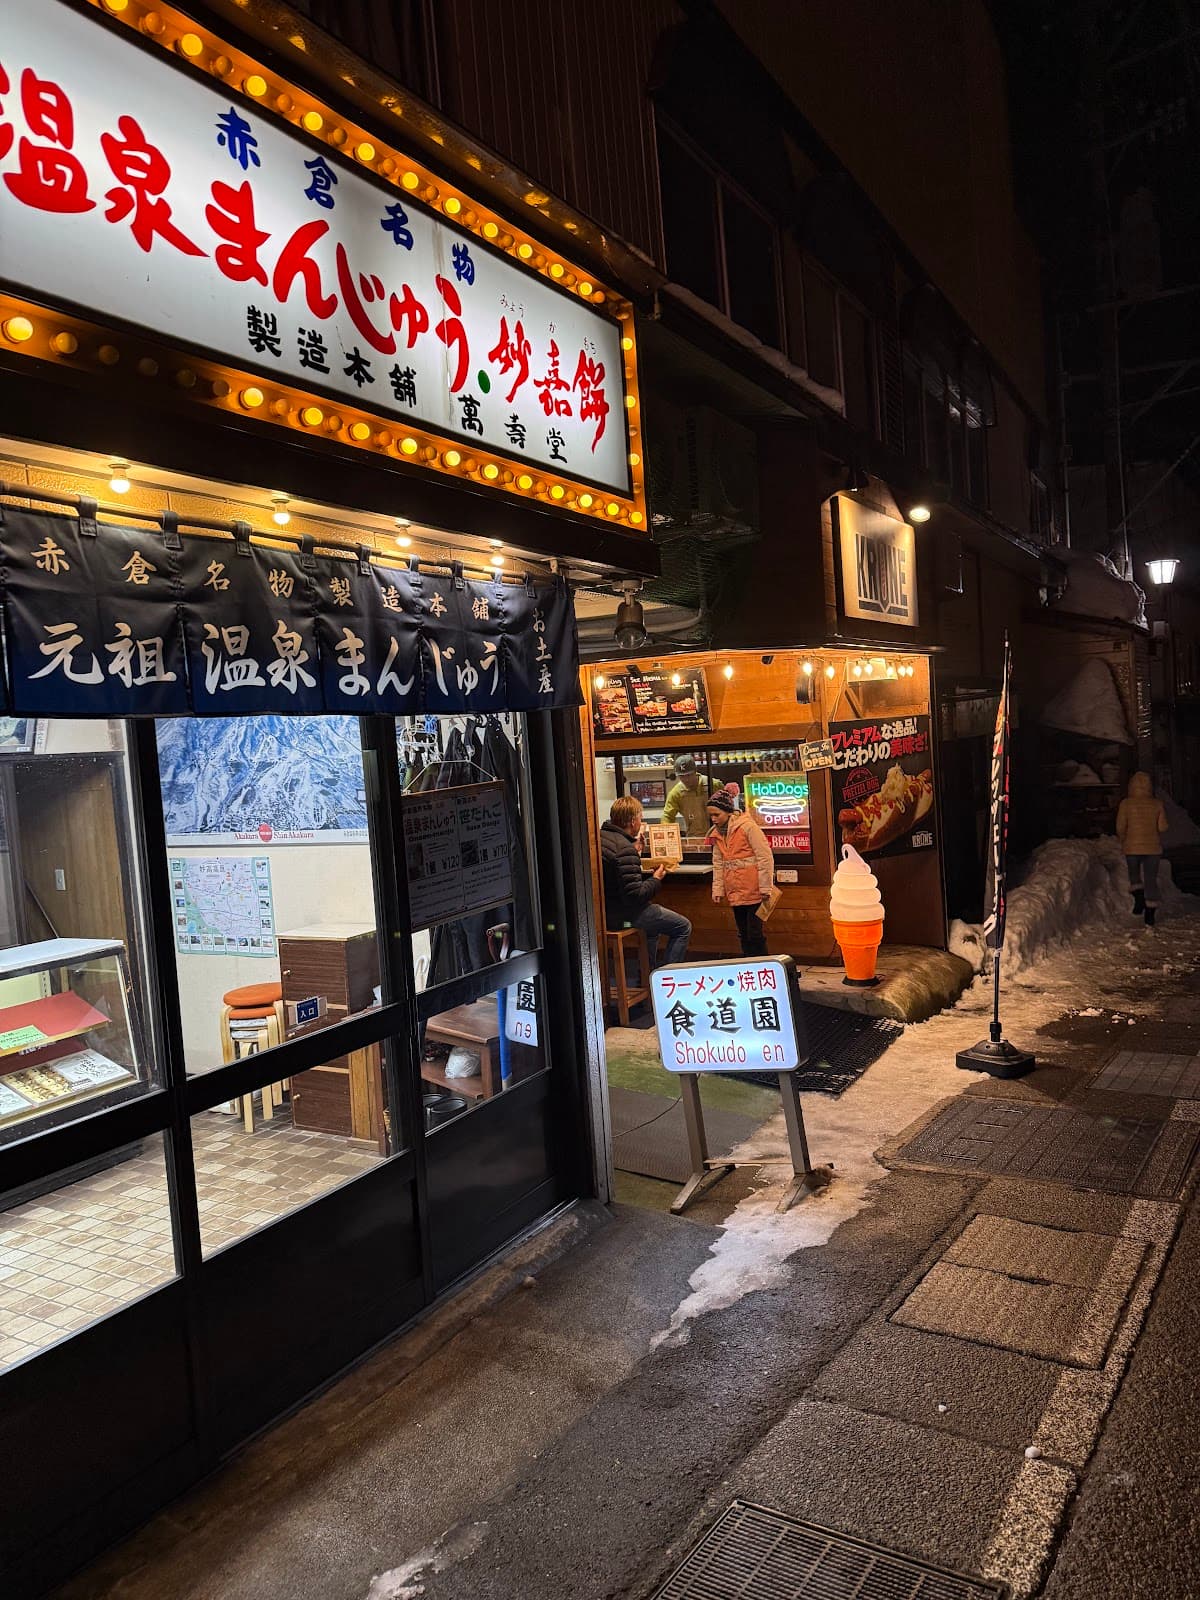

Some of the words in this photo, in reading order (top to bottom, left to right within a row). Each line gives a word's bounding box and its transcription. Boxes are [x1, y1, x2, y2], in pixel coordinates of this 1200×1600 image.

[215, 106, 475, 287] 赤倉名物
[532, 607, 557, 695] お土産
[750, 760, 803, 773] KRON
[804, 755, 833, 768] OPEN
[751, 782, 809, 798] HotDogs
[764, 814, 800, 825] OPEN
[233, 832, 258, 841] Akakura
[771, 834, 796, 848] BEER
[300, 1008, 315, 1019] 入口
[664, 996, 781, 1038] 食道園
[675, 1039, 746, 1065] Shokudo
[762, 1044, 785, 1062] en
